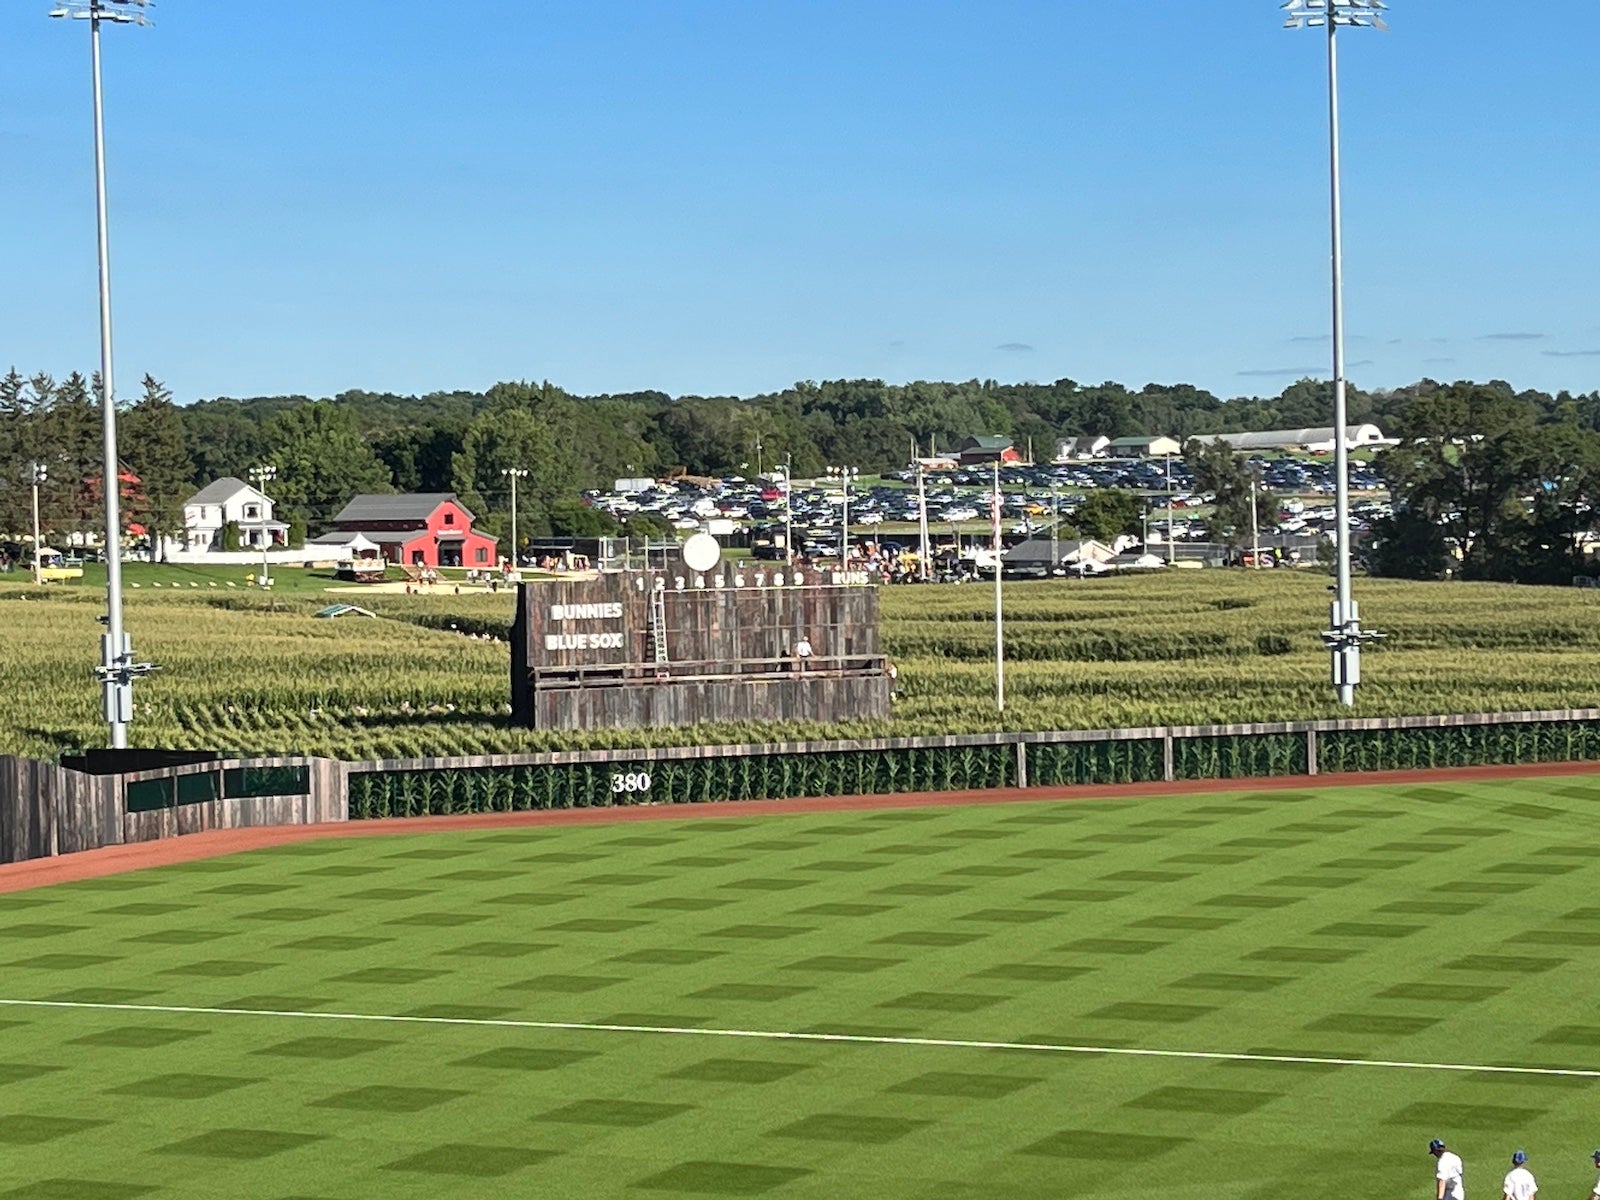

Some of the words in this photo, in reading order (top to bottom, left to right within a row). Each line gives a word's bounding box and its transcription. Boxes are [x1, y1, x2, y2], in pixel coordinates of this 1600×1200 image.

[636, 577, 644, 591] 1
[655, 577, 665, 590] 2
[675, 576, 685, 590] 3
[695, 575, 705, 588] 4
[715, 574, 725, 588] 5
[735, 574, 745, 588] 6
[754, 573, 764, 586] 7
[774, 573, 784, 586] 8
[794, 572, 804, 586] 9
[832, 571, 869, 584] RUNS
[551, 602, 623, 620] BUNNIES
[545, 634, 587, 650] BLUE
[588, 632, 624, 650] SOX
[612, 772, 652, 793] 380
